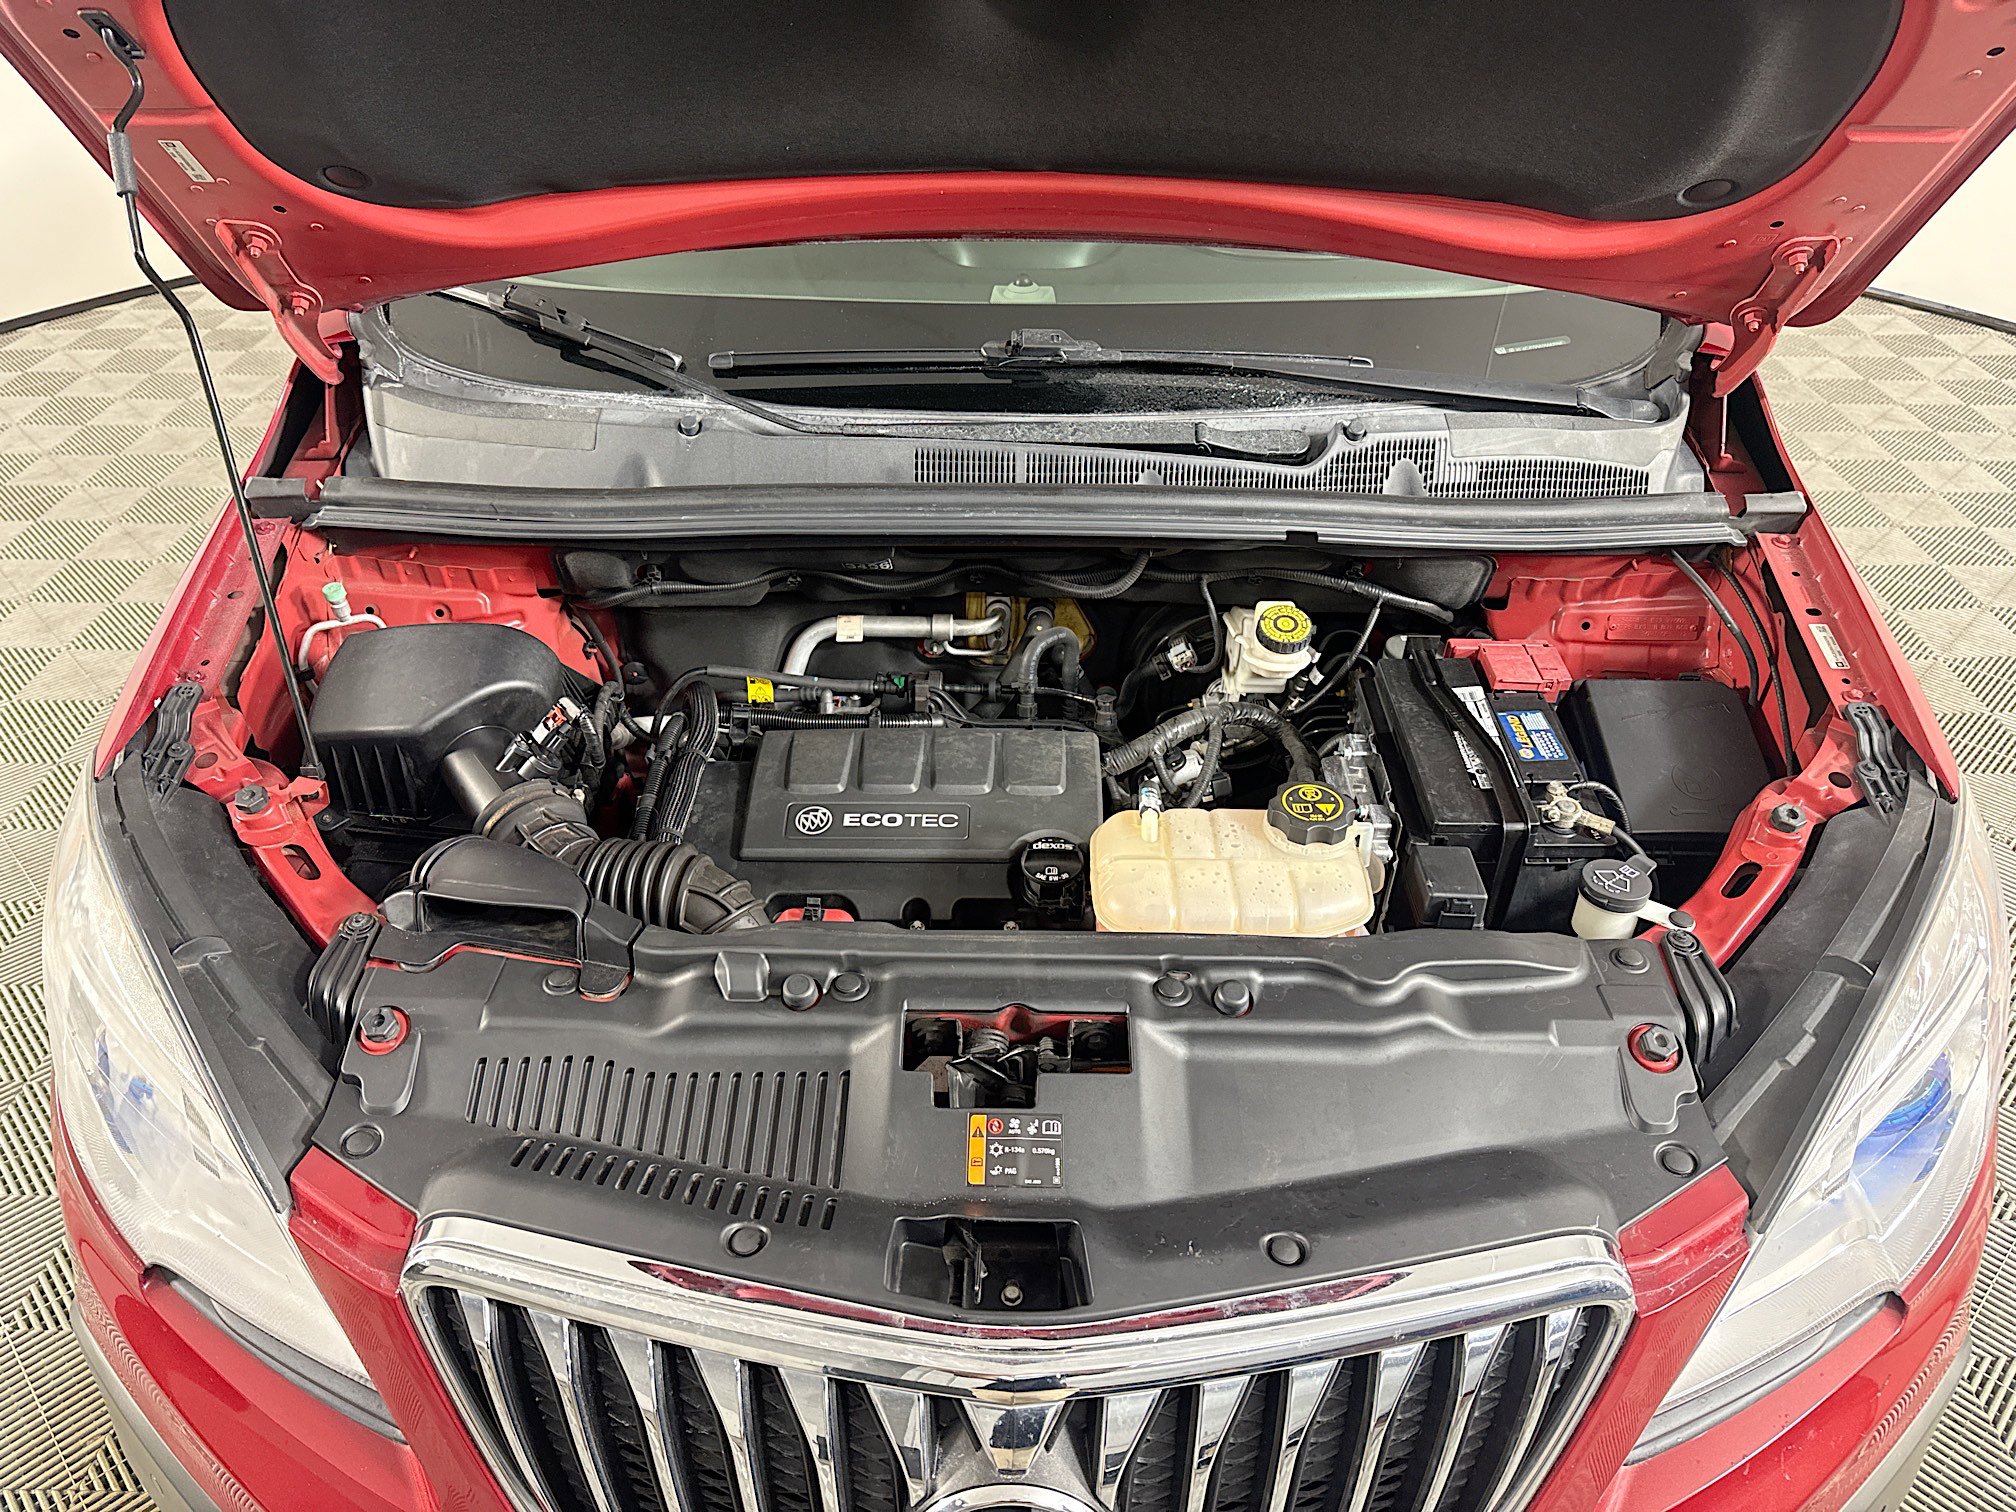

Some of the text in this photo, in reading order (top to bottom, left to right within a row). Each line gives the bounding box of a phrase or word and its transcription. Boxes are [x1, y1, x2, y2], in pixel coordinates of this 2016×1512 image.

[1506, 714, 1534, 748] LEGEND
[843, 813, 959, 828] ECOTEC
[1032, 841, 1075, 851] dexos
[1035, 872, 1069, 881] SAE 5W-30
[1004, 1167, 1017, 1175] PAG
